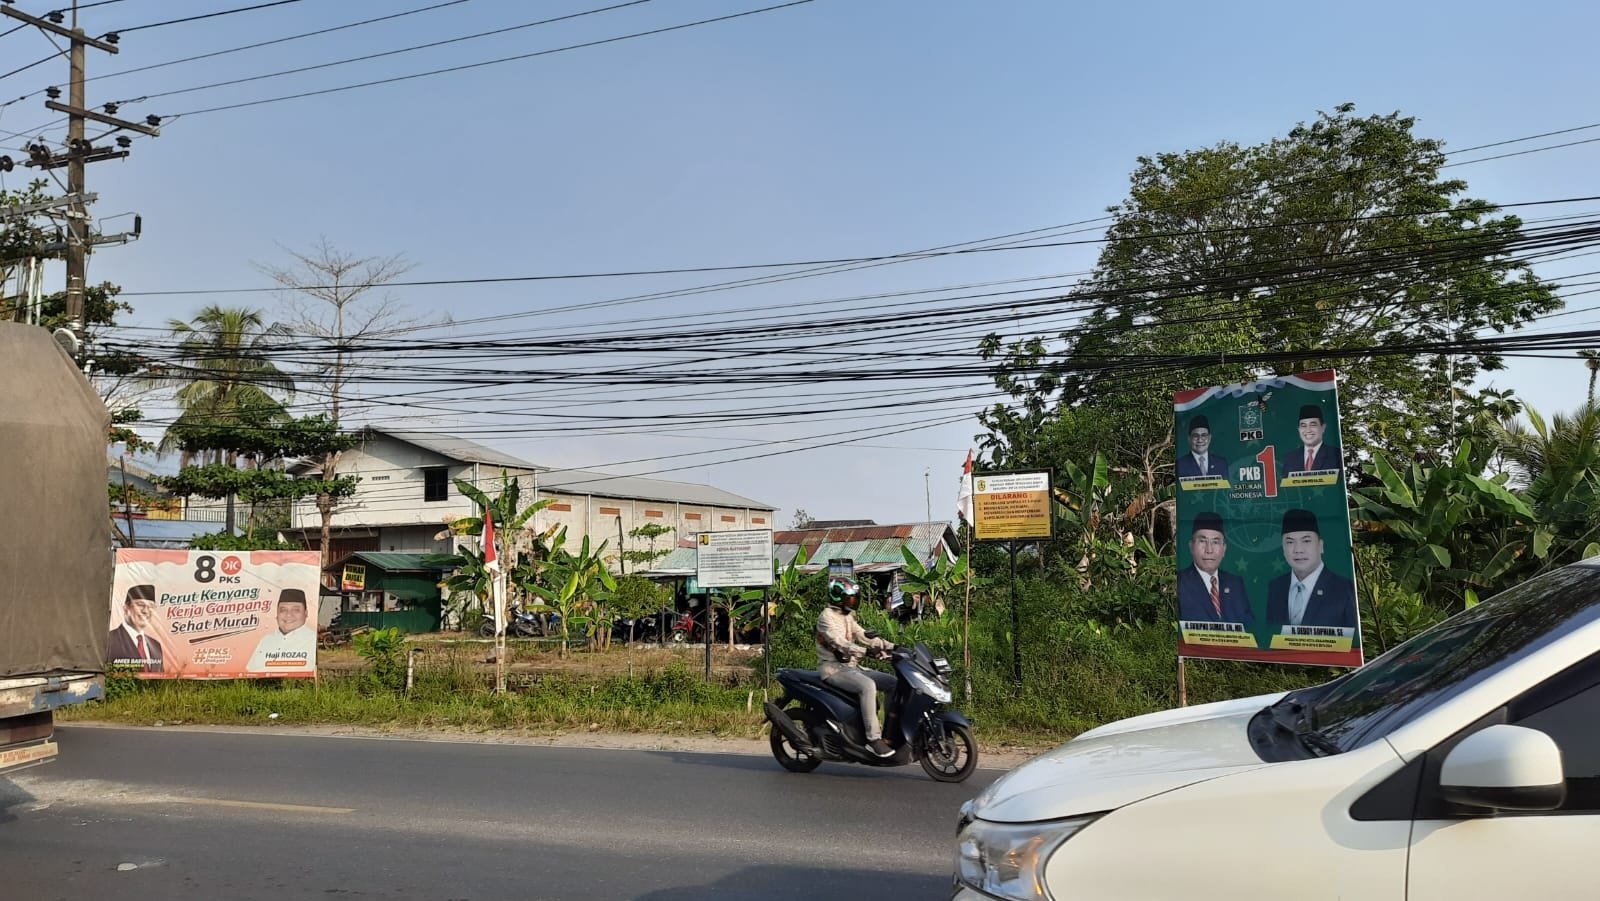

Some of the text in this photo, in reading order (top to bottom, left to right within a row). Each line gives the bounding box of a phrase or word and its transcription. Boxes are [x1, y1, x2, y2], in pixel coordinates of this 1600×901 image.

[1241, 431, 1263, 440] PKB
[1240, 445, 1278, 498] PKB 1
[1234, 483, 1262, 491] SATUKAN
[991, 492, 1028, 500] DILARANG
[1229, 491, 1263, 499] INDONESIA
[194, 555, 216, 583] 8
[219, 576, 241, 584] PKS
[160, 587, 260, 605] Perut Kenyang
[167, 600, 271, 618] Kerja Gampang
[171, 614, 259, 633] Sehat Murah
[281, 651, 308, 659] ROZAQ
